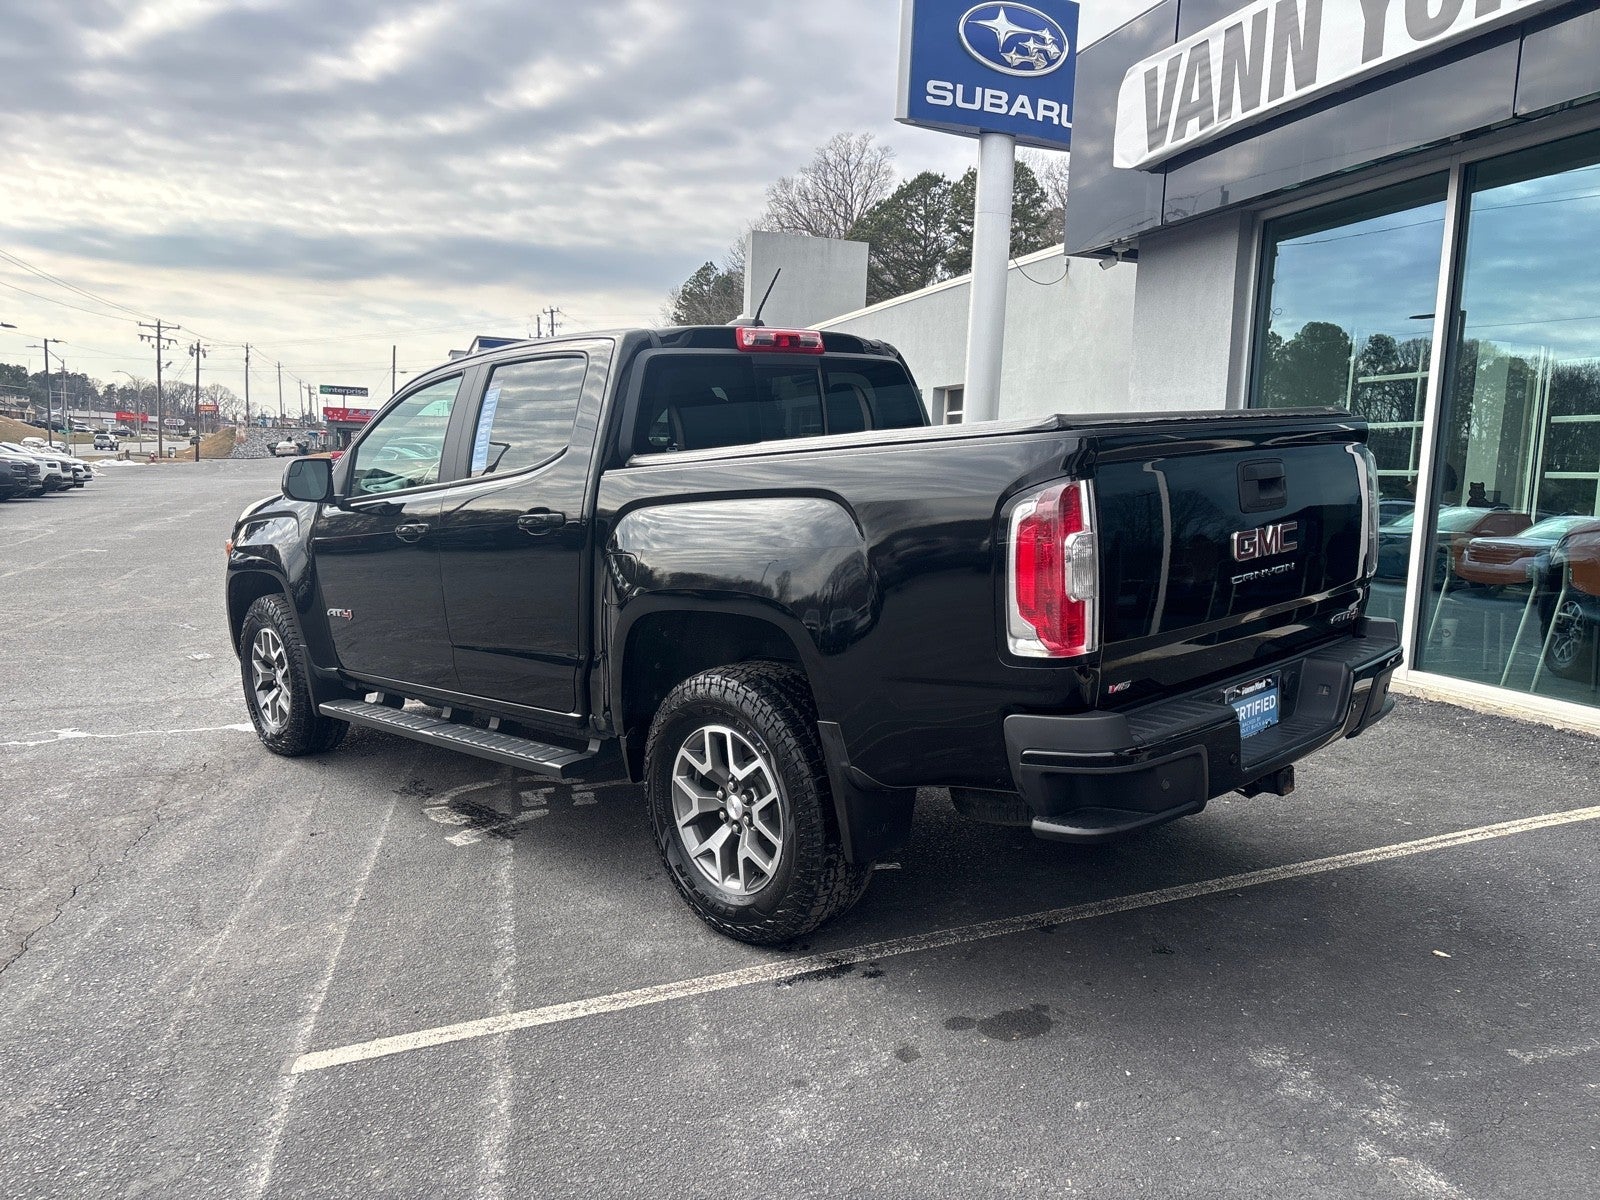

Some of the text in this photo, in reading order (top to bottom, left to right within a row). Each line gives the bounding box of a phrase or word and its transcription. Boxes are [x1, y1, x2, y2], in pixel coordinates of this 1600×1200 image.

[1144, 0, 1321, 153] VANN
[1231, 521, 1298, 562] GMC
[1231, 562, 1296, 585] CANYON
[326, 608, 354, 621] AT4
[1235, 694, 1276, 721] RTIFIED
